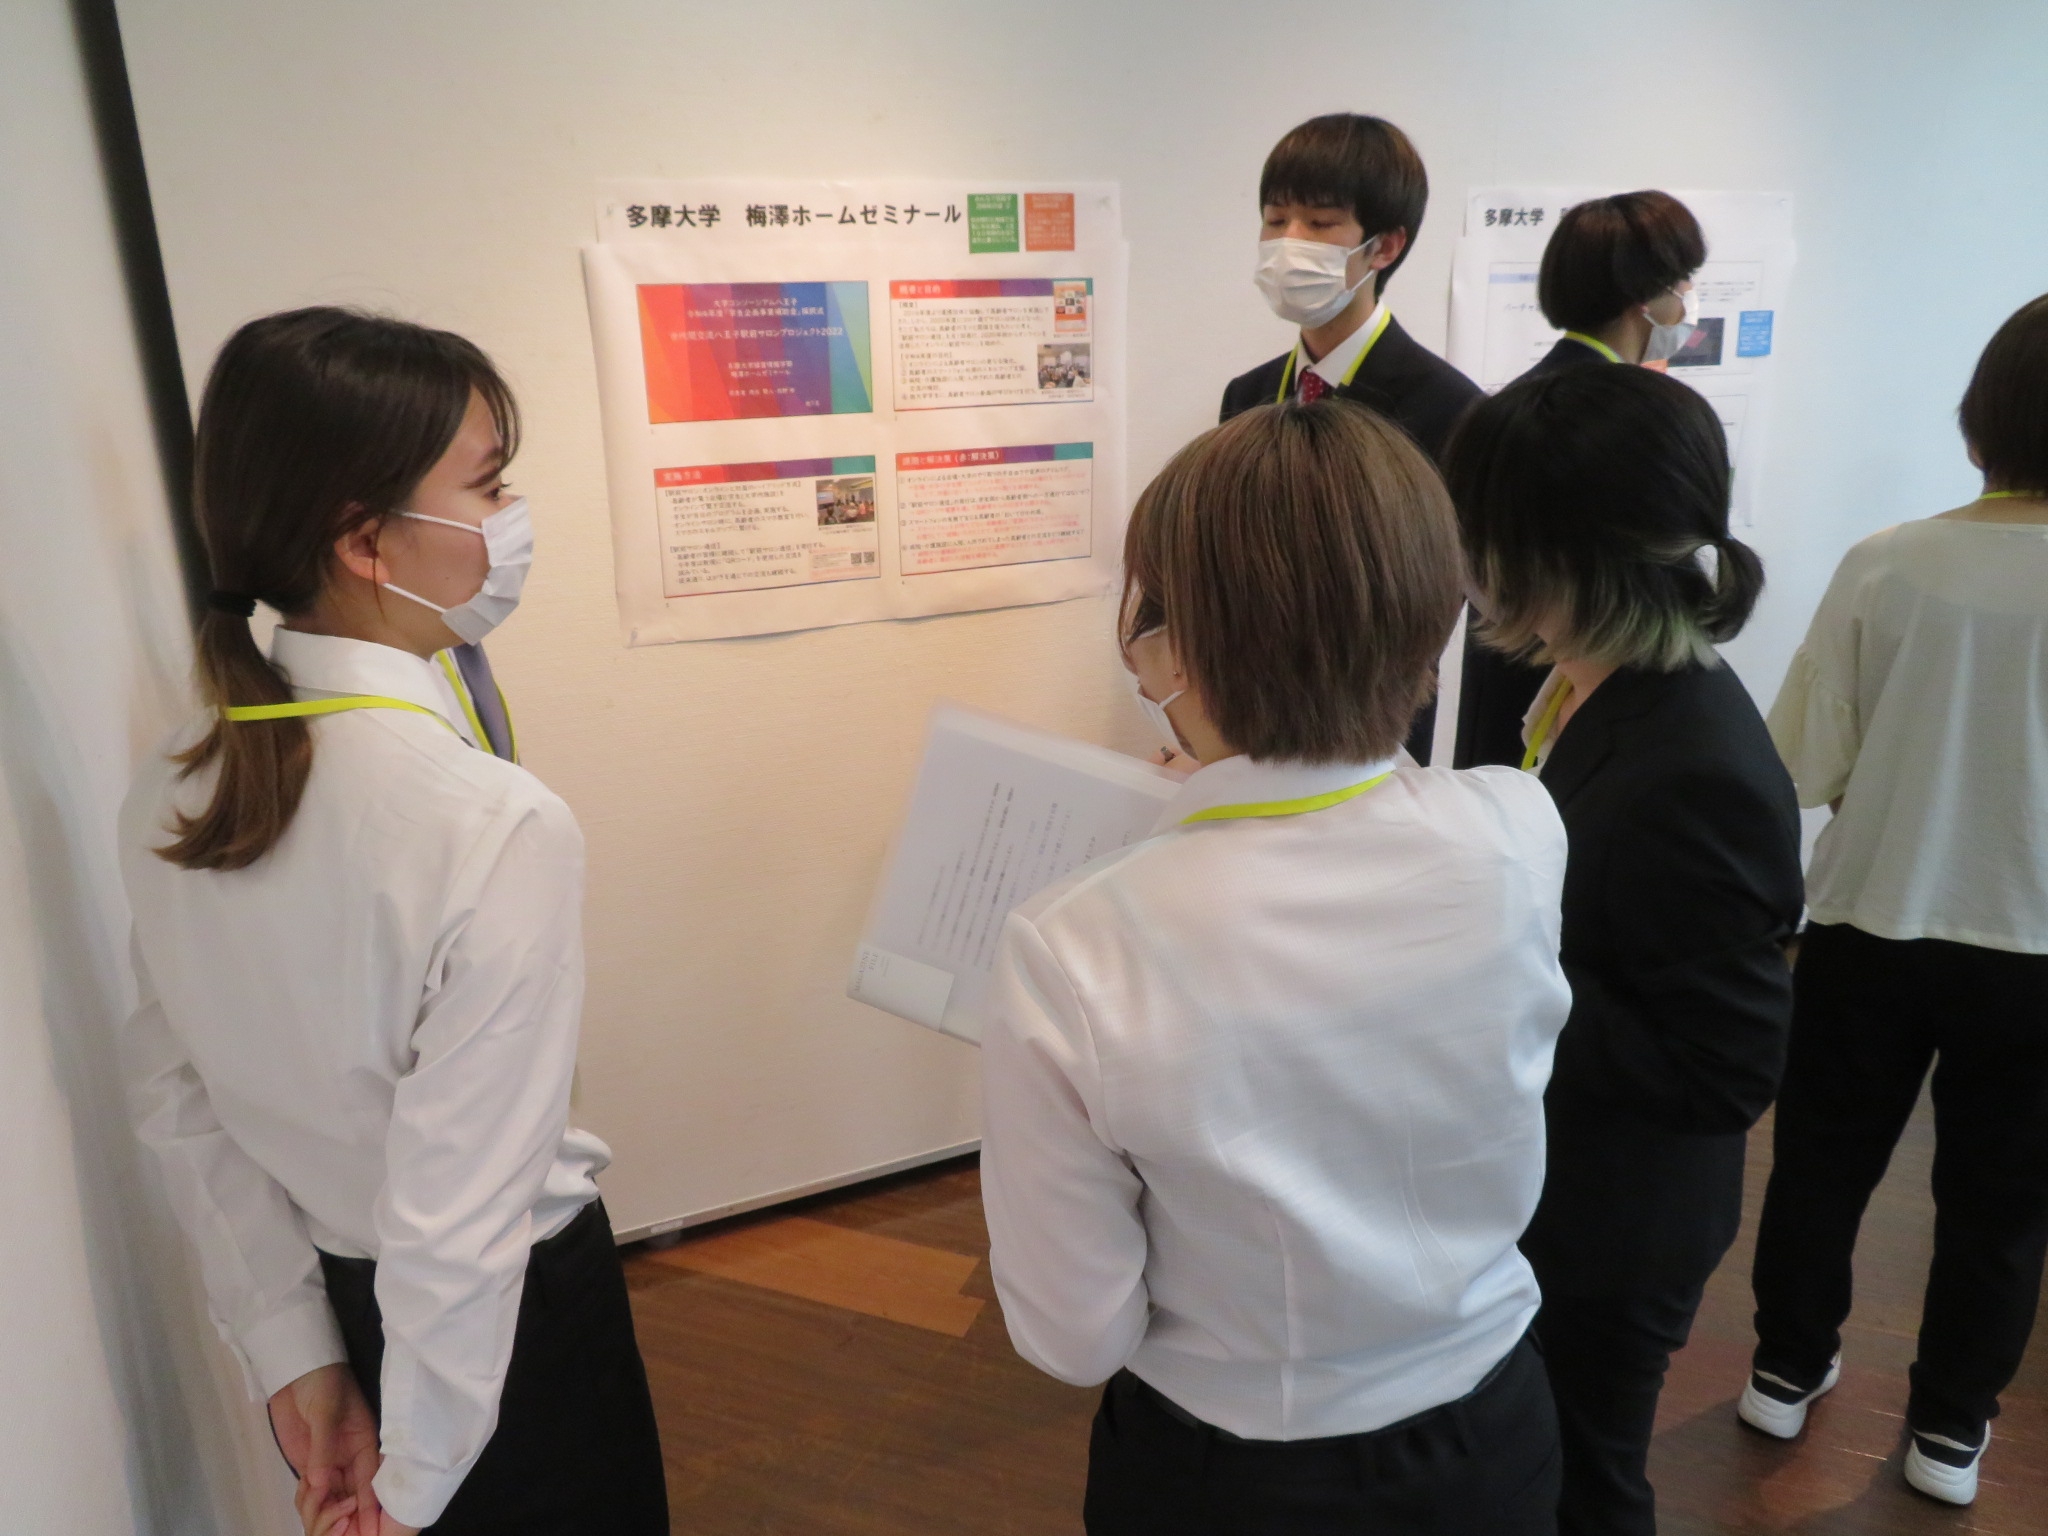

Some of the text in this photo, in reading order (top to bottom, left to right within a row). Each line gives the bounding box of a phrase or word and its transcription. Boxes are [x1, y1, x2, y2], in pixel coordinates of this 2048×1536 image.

[626, 204, 721, 228] 多摩大学
[746, 204, 962, 228] 梅澤ホームゼミナール
[1485, 207, 1544, 227] 多摩大学
